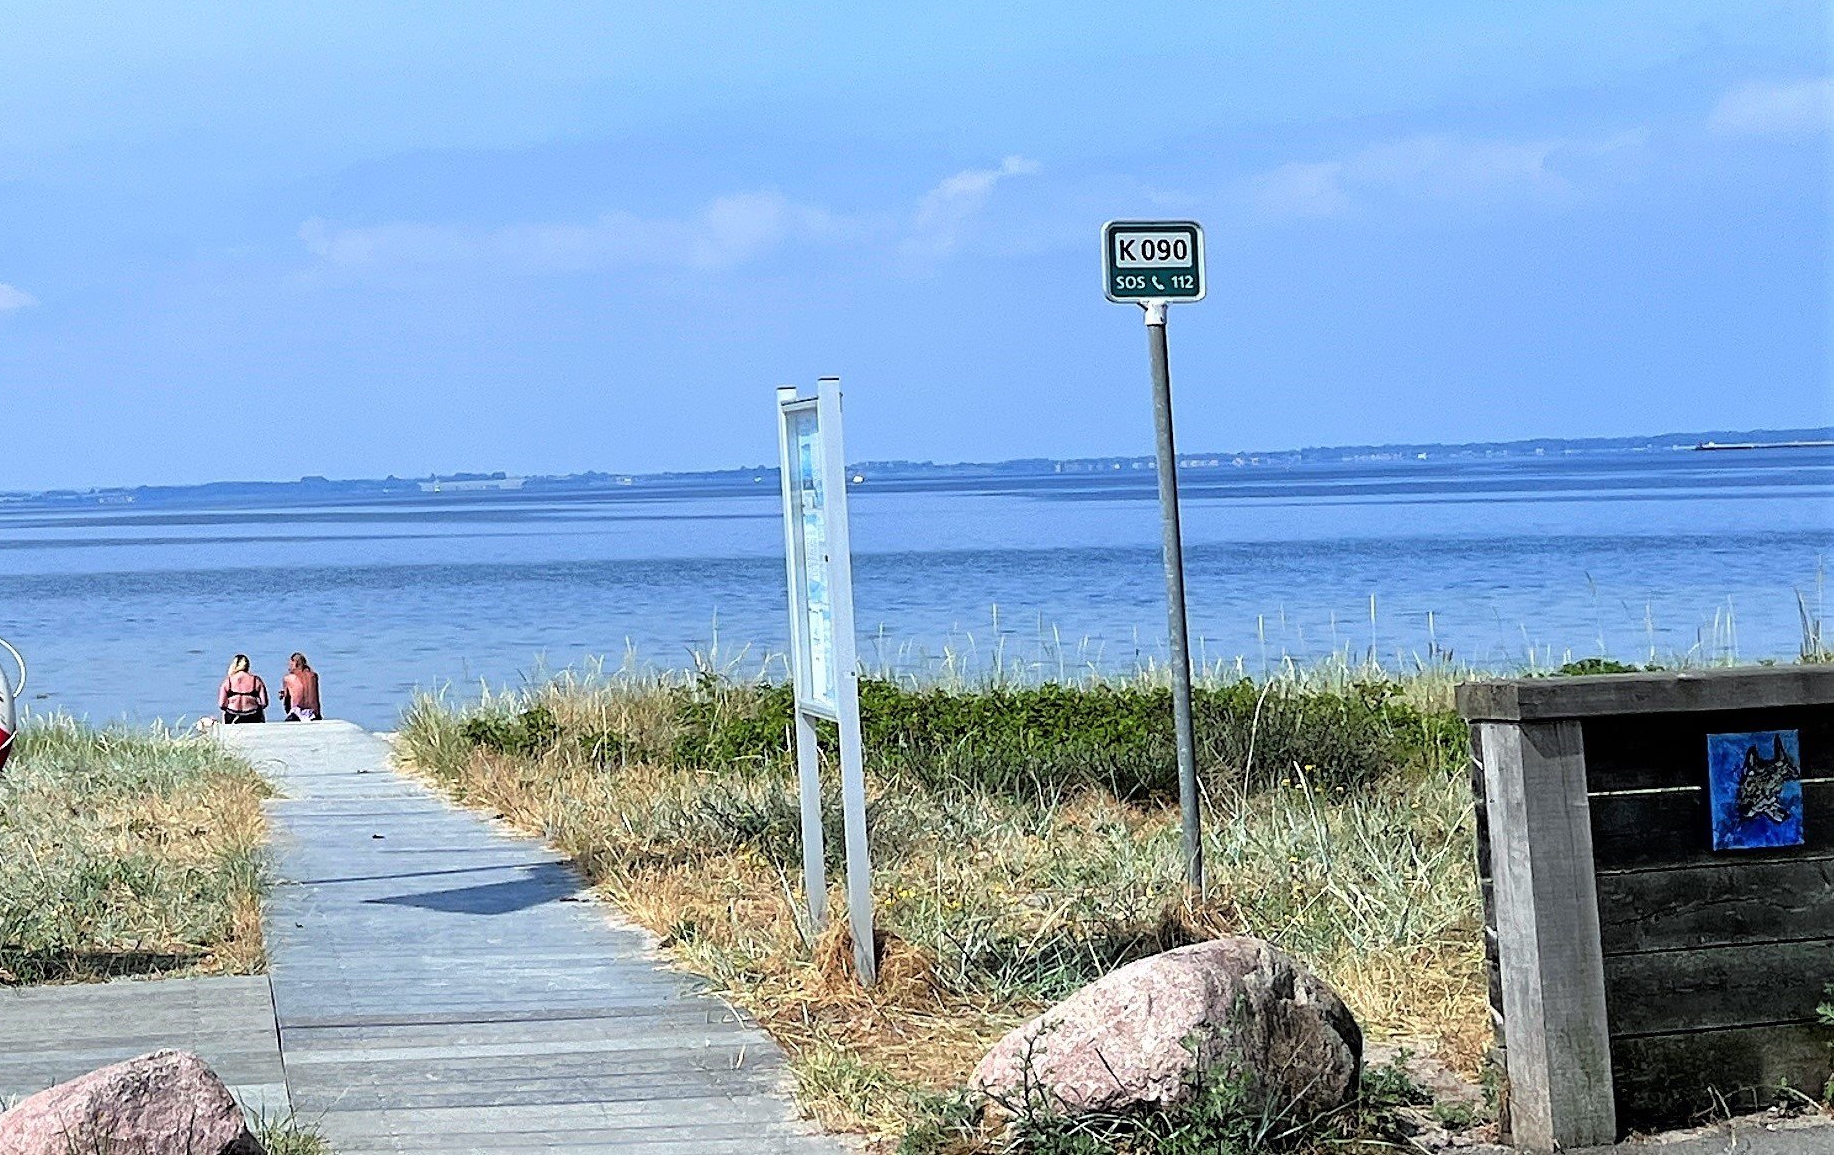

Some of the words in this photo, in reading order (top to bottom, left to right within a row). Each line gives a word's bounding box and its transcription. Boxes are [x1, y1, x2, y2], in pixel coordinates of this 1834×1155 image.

[1119, 239, 1136, 261] K
[1141, 239, 1187, 261] 090
[1116, 275, 1146, 290] SOS
[1171, 275, 1194, 289] 112
